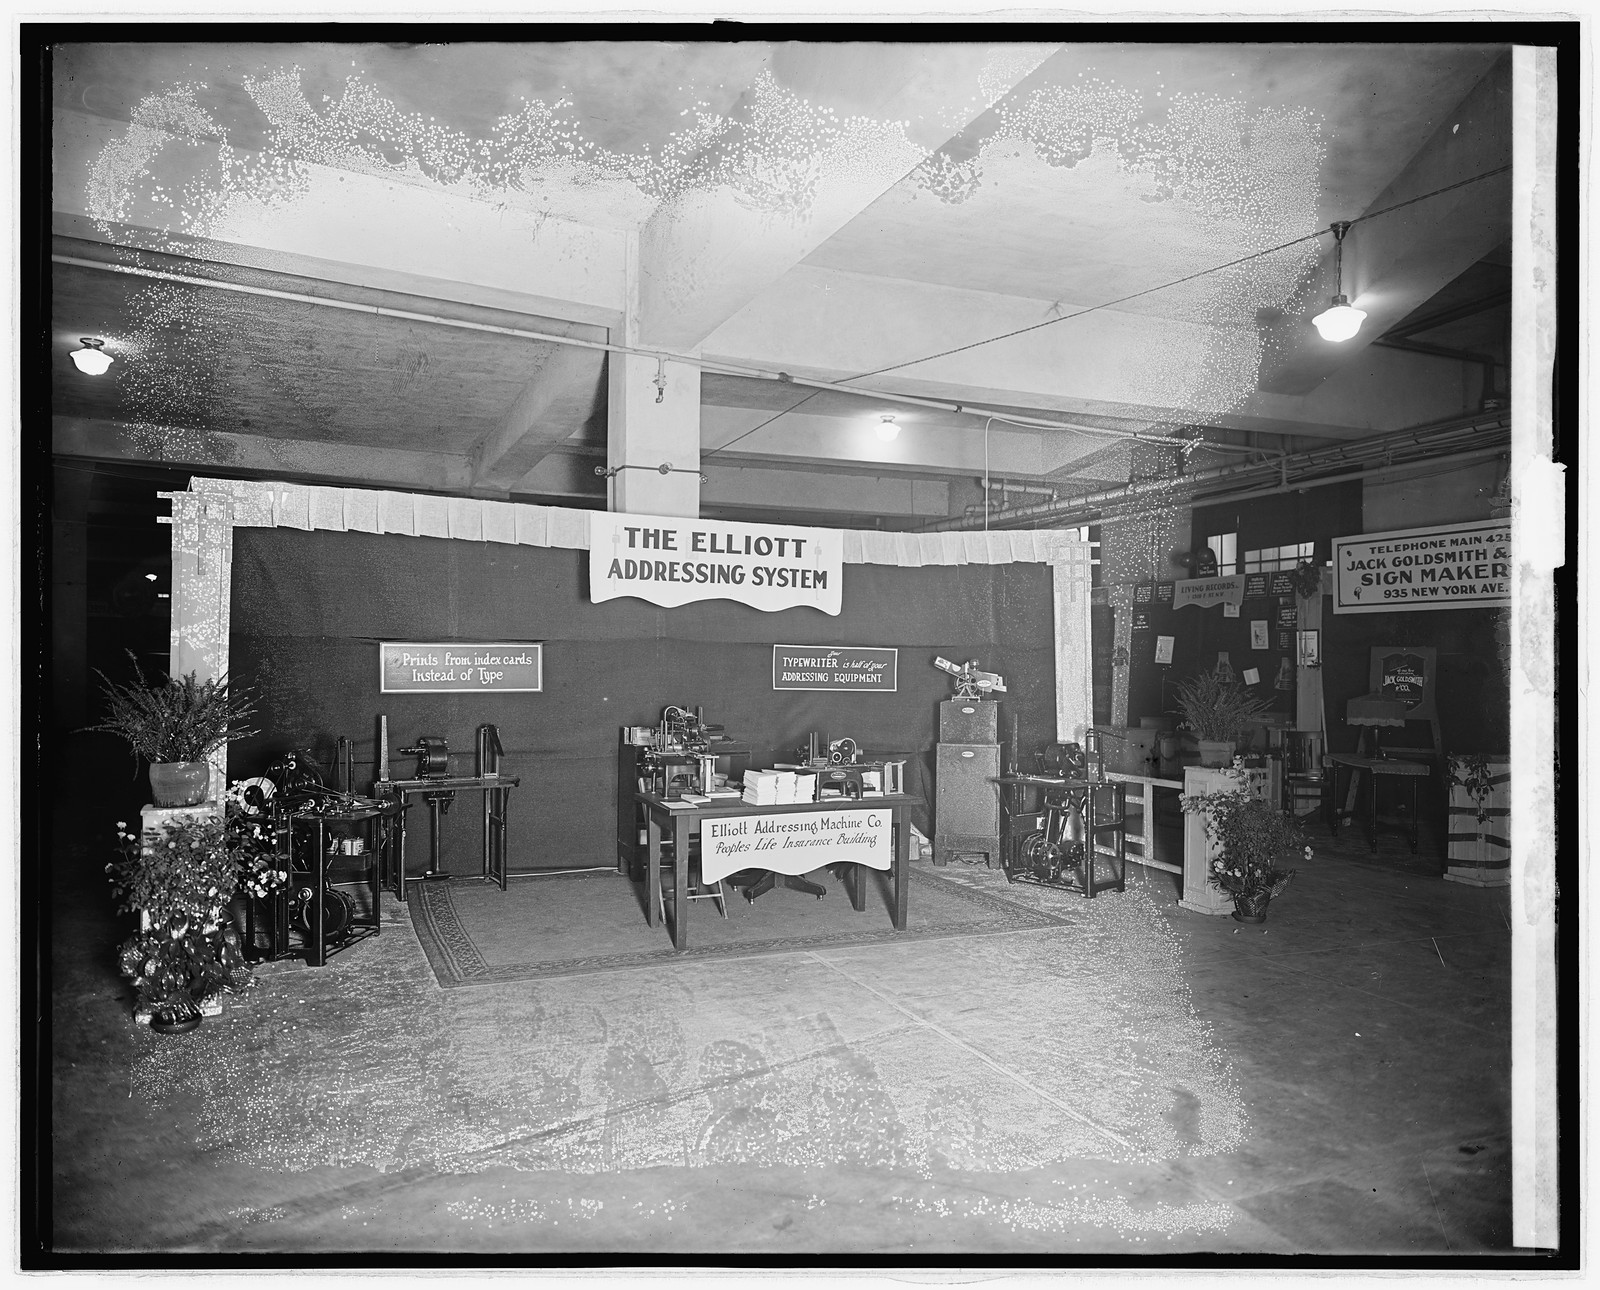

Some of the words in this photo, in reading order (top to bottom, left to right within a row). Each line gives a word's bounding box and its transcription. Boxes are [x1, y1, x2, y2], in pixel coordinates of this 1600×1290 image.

[624, 526, 678, 551] THE
[691, 531, 807, 559] ELLIOTT
[1369, 540, 1447, 555] TELEPHONE
[1450, 535, 1482, 547] MAIN
[1346, 558, 1387, 571] JACK
[1392, 548, 1488, 568] GOLDSMITH
[607, 558, 746, 585] ADDRESSING
[751, 566, 828, 589] SYSTEM
[1361, 570, 1413, 586] SIGN
[1420, 562, 1511, 582] MAKER
[1181, 584, 1205, 593] LIVING
[1384, 588, 1408, 599] 935
[1411, 586, 1439, 598] NEW
[1442, 584, 1477, 596] YORK
[1480, 582, 1509, 594] AVE.
[402, 652, 439, 666] Prints
[444, 651, 472, 666] from
[474, 652, 501, 666] index
[503, 652, 533, 665] cards
[782, 657, 839, 668] TYPEWRITER
[842, 659, 850, 669] is
[850, 660, 866, 669] half
[862, 660, 873, 669] of
[867, 662, 888, 672] your
[412, 668, 457, 682] Instead
[460, 667, 473, 681] of
[477, 667, 504, 684] Type
[781, 671, 829, 682] ADDRESSING
[834, 673, 882, 684] EQUIPMENT
[711, 820, 748, 838] Elliott
[754, 819, 819, 835] Addressing
[820, 815, 863, 830] Machine
[867, 814, 883, 828] Co.
[715, 841, 751, 857] Peoples
[754, 837, 778, 852] Life
[782, 835, 833, 850] Insurance
[836, 832, 878, 848] Building
